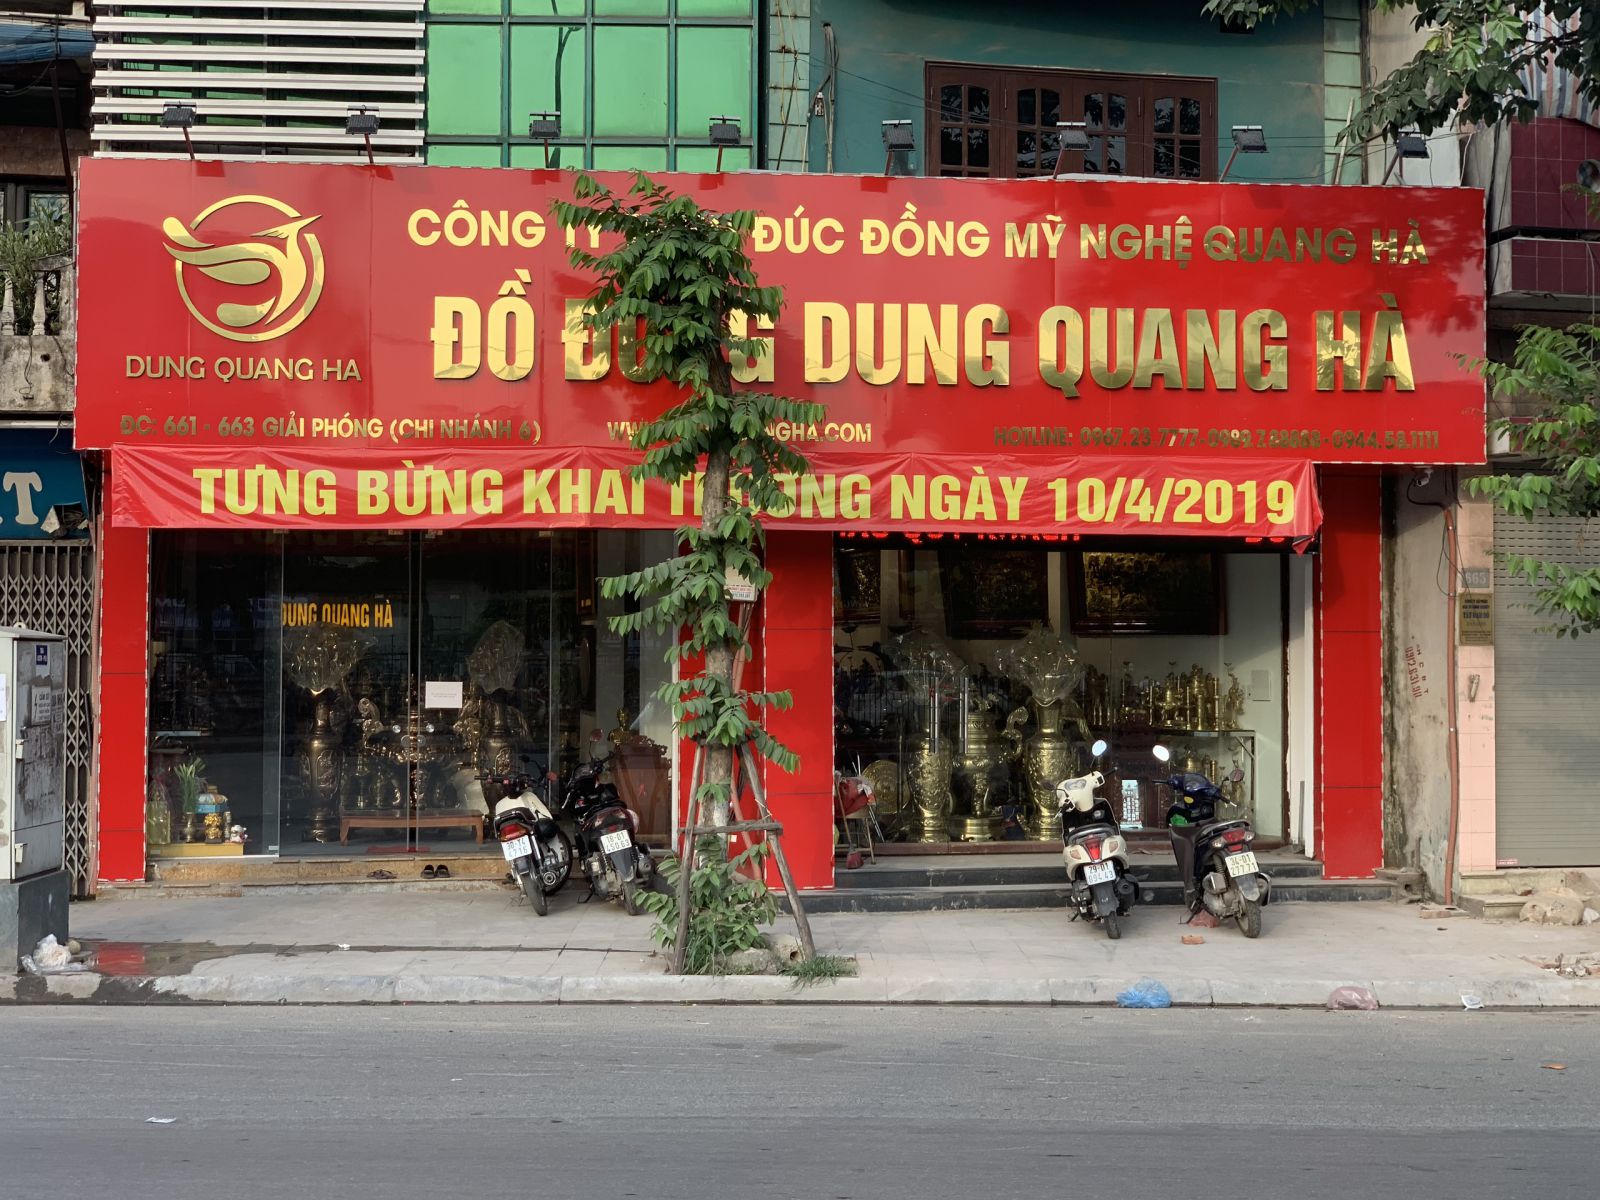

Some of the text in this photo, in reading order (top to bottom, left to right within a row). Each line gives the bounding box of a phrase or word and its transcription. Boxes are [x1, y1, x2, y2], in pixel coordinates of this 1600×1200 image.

[407, 199, 546, 248] CÔNG
[752, 206, 844, 254] ĐÚC
[860, 201, 989, 258] ĐỒNG
[1004, 215, 1066, 259] MỸ
[1080, 216, 1192, 269] NGHỆ
[1204, 226, 1357, 265] QUANG
[1371, 219, 1429, 265] HÀ
[431, 268, 536, 381] ĐỒ
[804, 302, 1010, 387] DUNG
[1038, 305, 1288, 397] QUANG
[1316, 294, 1416, 391] HÀ
[126, 355, 361, 382] DUNG QUANG HA
[164, 416, 197, 436] 661
[218, 416, 254, 437] 663
[262, 411, 304, 438] GIẢI
[312, 412, 383, 438] PHÓNG
[389, 417, 434, 444] (CHI
[440, 413, 511, 440] NHÁNH
[519, 419, 541, 445] 6)
[994, 426, 1073, 447] HOTLINE:
[192, 463, 337, 516] TƯNG
[356, 459, 504, 516] BỪNG
[522, 468, 647, 515] KHAI
[890, 466, 1030, 520] NGÀY
[1047, 477, 1296, 524] 10/4/2019
[374, 600, 393, 628] HÀ
